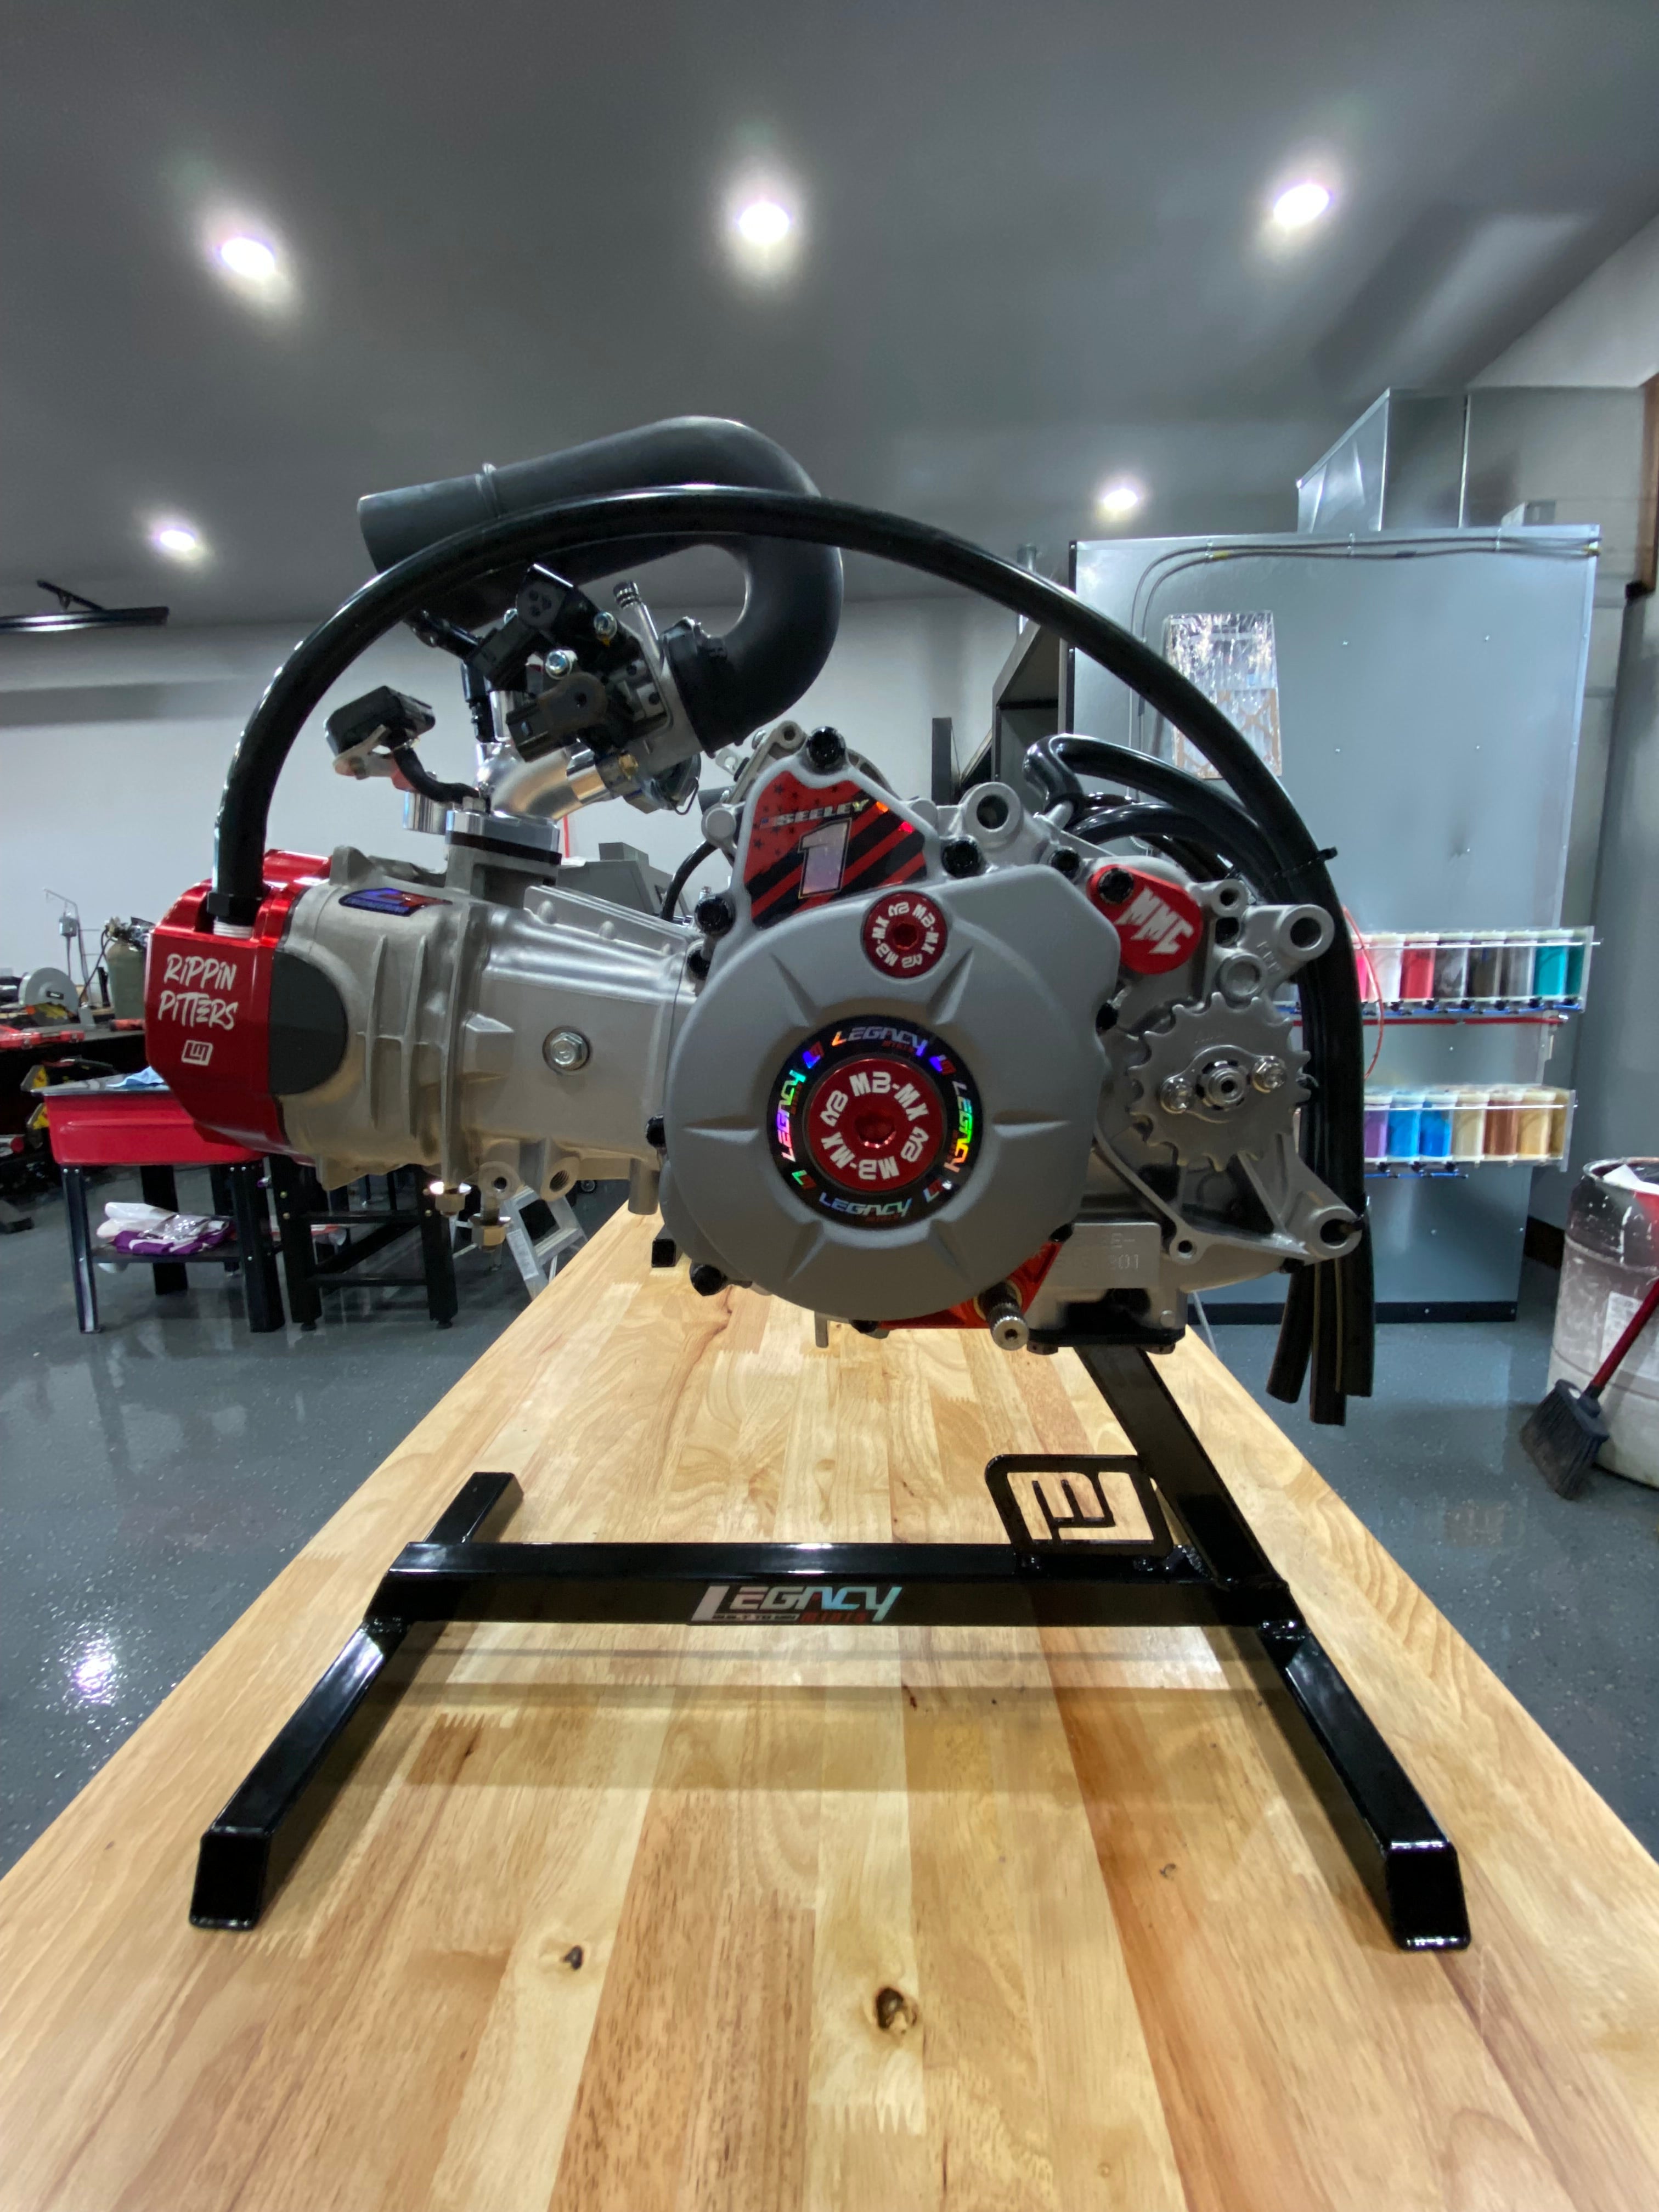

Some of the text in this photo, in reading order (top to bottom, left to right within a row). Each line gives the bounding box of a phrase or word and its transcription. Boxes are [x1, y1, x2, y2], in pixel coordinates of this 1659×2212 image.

[799, 817, 852, 899] 1
[1114, 887, 1194, 954] MMC
[831, 1026, 928, 1057] LEGACY
[777, 1070, 806, 1163] LEGACY
[849, 1071, 929, 1121] MB-MX
[944, 1081, 973, 1172] LEGACY
[821, 1132, 900, 1180] MB-MX
[819, 1192, 912, 1217] LEGACY
[691, 1585, 902, 1622] LEGACY
